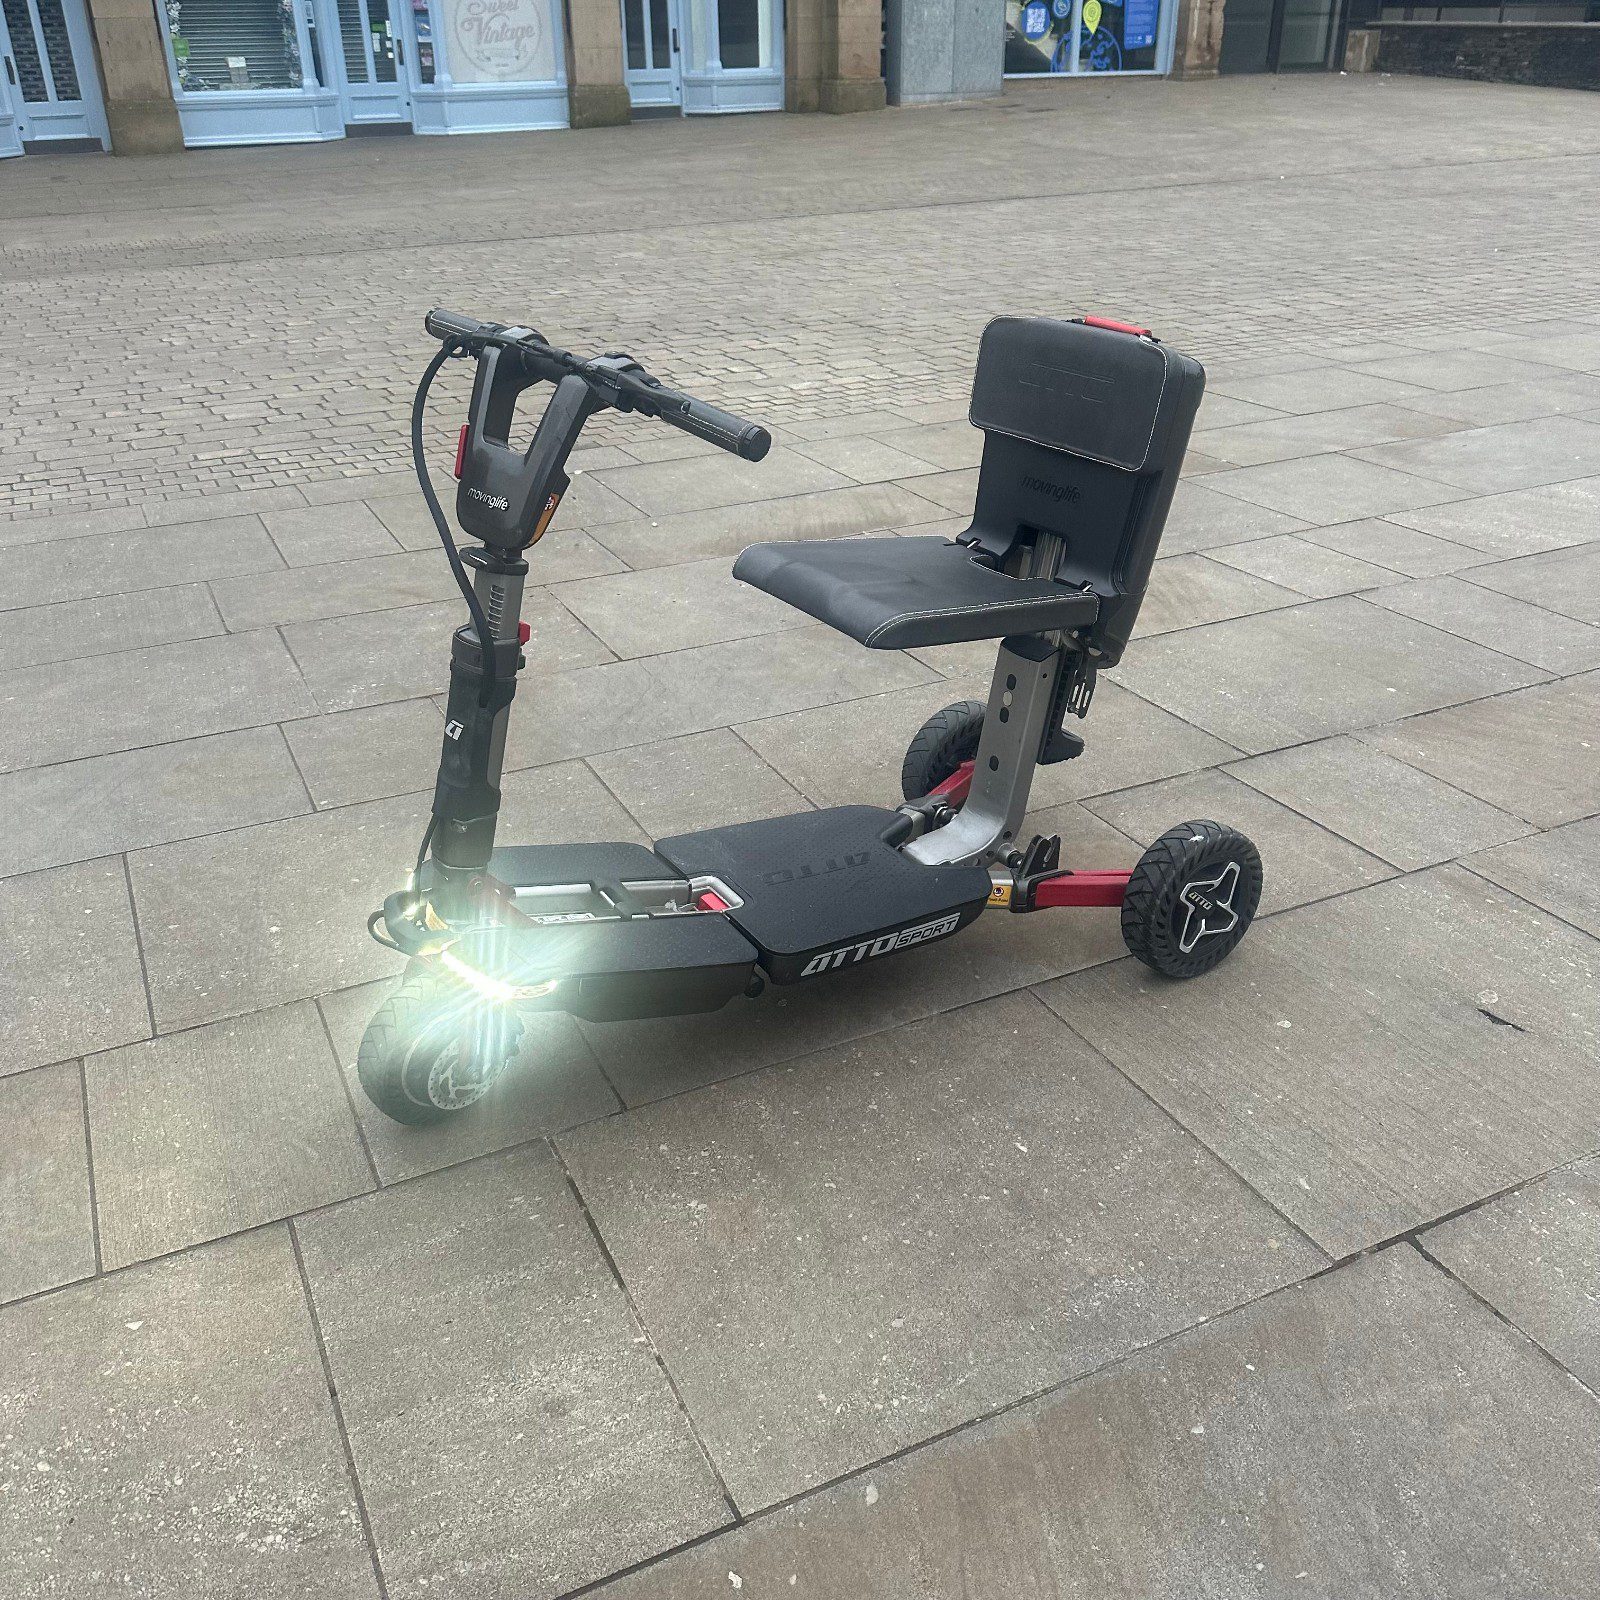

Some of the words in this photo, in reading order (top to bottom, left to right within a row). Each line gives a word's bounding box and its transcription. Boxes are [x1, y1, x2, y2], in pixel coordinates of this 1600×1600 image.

[461, 12, 536, 55] Vintage
[467, 487, 509, 511] movinglife
[896, 912, 961, 949] SPORT
